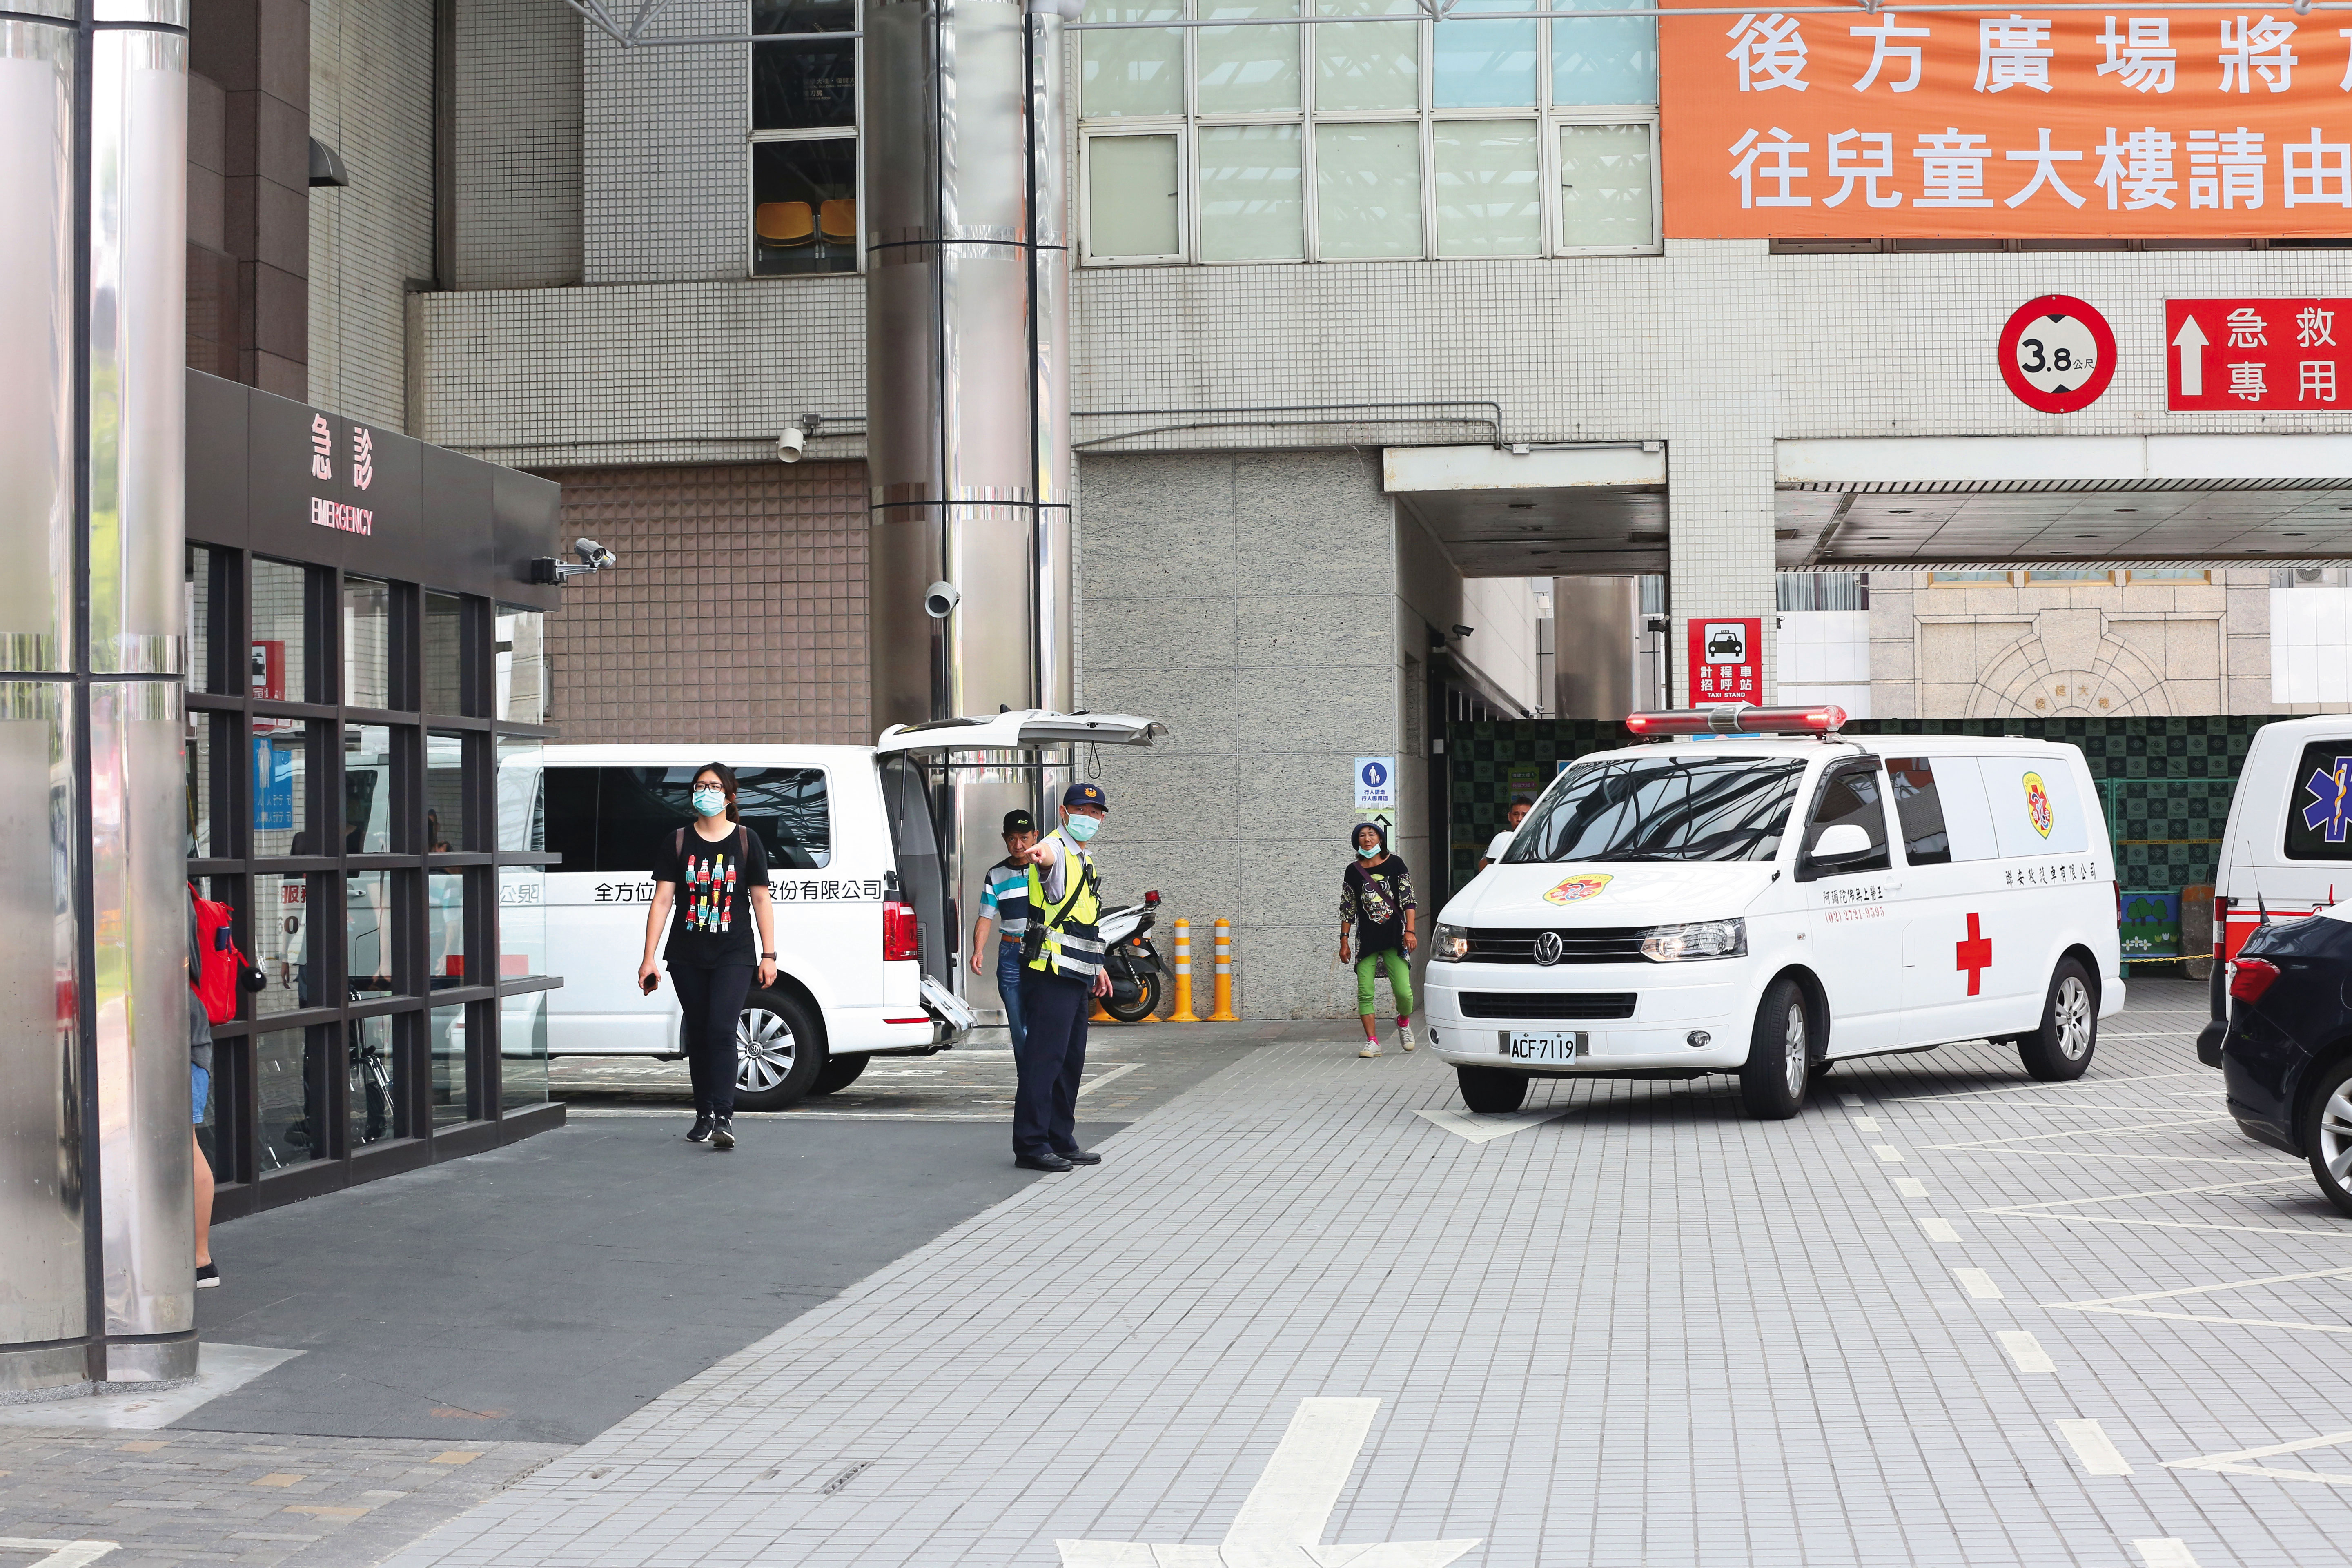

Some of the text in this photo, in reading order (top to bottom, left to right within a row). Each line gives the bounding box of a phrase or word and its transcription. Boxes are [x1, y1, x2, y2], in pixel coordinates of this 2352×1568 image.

[1725, 13, 2352, 94] 後方廣場將
[1728, 126, 2352, 210] 往兒童大樓請由
[2226, 307, 2336, 348] 急救
[2022, 339, 2094, 373] 3.8 公尺
[2227, 361, 2336, 402] 專用
[312, 413, 373, 491] 急診
[311, 497, 373, 536] EMERGENCY
[1700, 666, 1752, 678] 計程車
[1701, 679, 1752, 691] 招呼站
[595, 882, 654, 902] 全方位
[1843, 906, 1884, 921] 2721-9595
